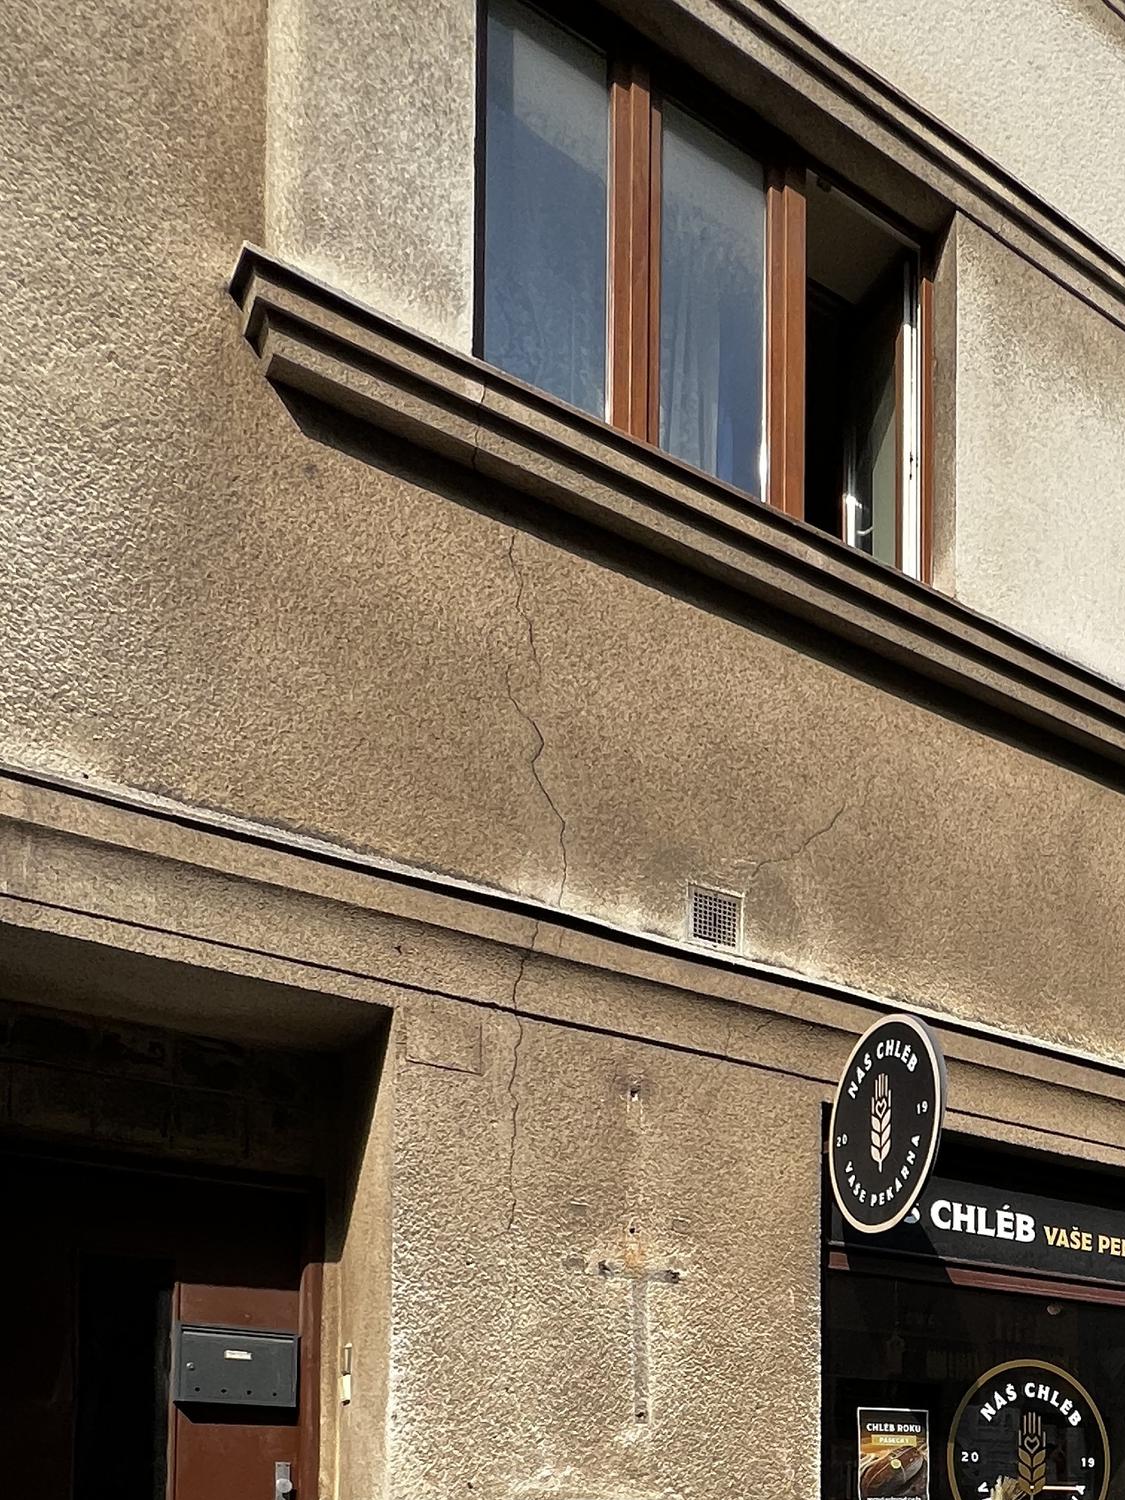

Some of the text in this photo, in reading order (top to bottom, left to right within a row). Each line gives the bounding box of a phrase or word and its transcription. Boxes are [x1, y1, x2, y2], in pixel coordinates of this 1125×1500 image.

[836, 1100, 928, 1147] 20 19
[930, 1200, 1036, 1243] CHLÉB
[1043, 1224, 1093, 1252] VAŠE
[980, 1382, 1082, 1427] NÁŠ CHLÉB
[897, 1424, 921, 1433] ROKU
[961, 1451, 1095, 1468] 20 19
